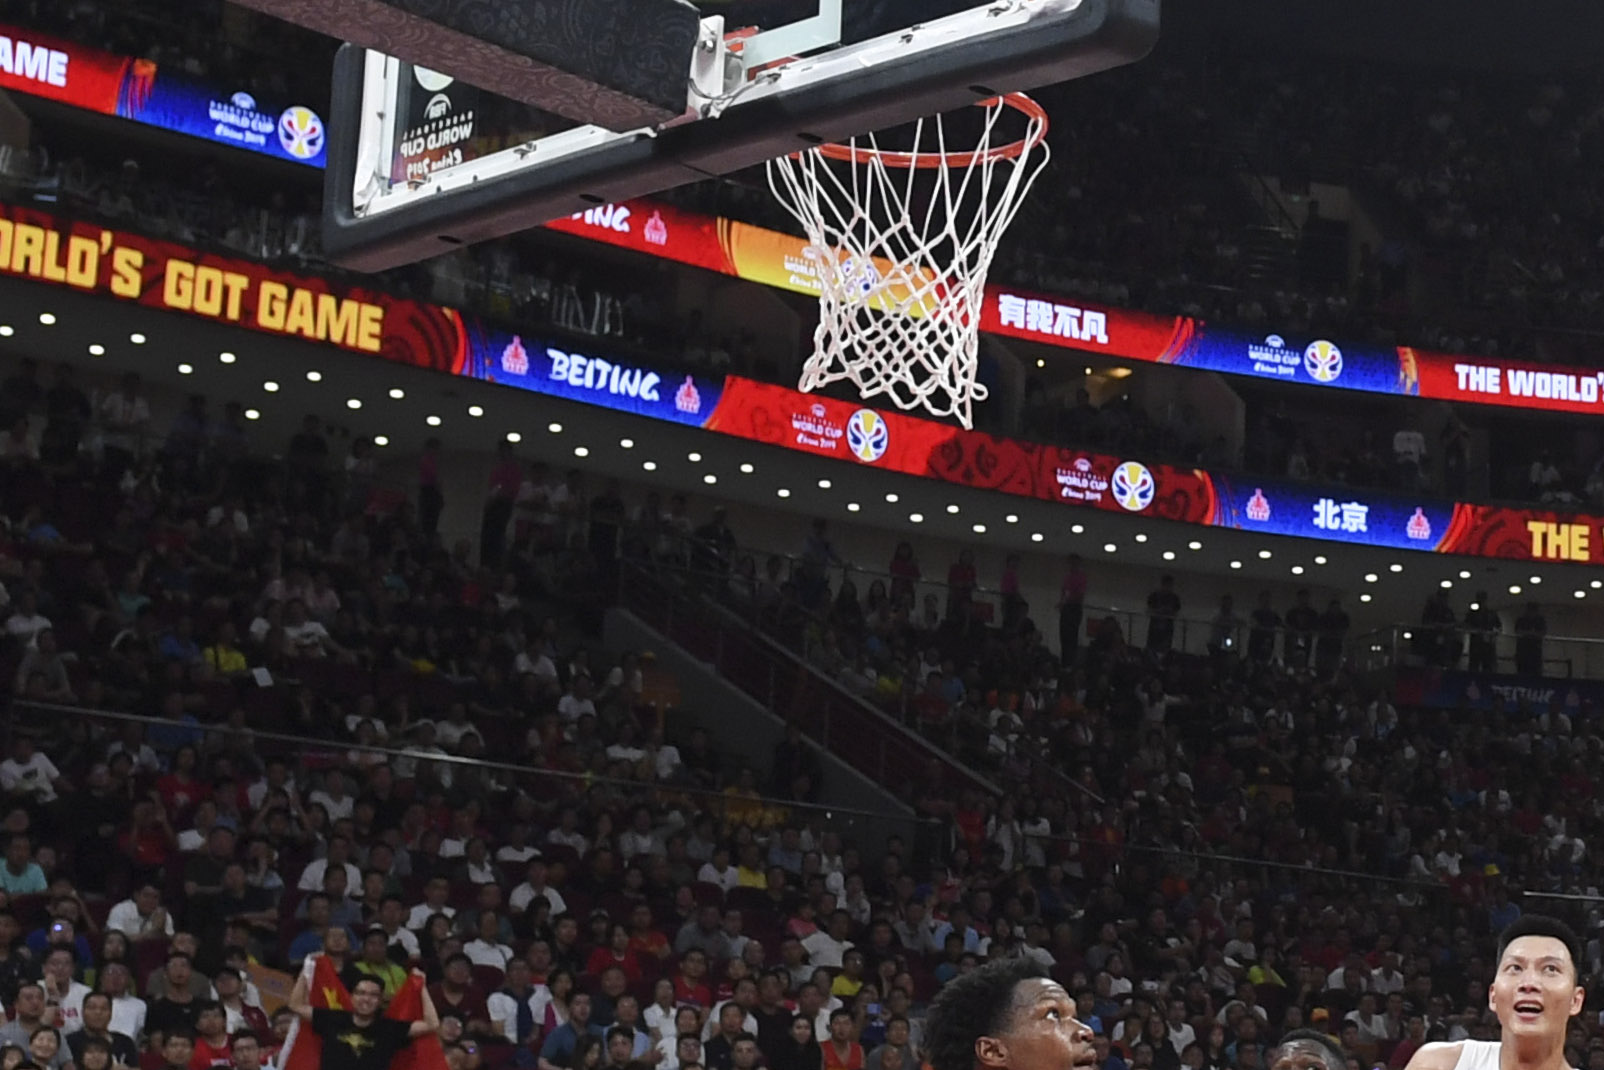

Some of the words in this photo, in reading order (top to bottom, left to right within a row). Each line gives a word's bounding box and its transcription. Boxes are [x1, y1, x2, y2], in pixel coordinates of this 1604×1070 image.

[572, 203, 631, 233] ING
[164, 258, 248, 321] GOT
[258, 280, 383, 351] GAME
[999, 294, 1108, 344] 有我不凡
[1455, 364, 1500, 394] THE
[1313, 499, 1367, 532] 北京
[1527, 521, 1590, 562] THE
